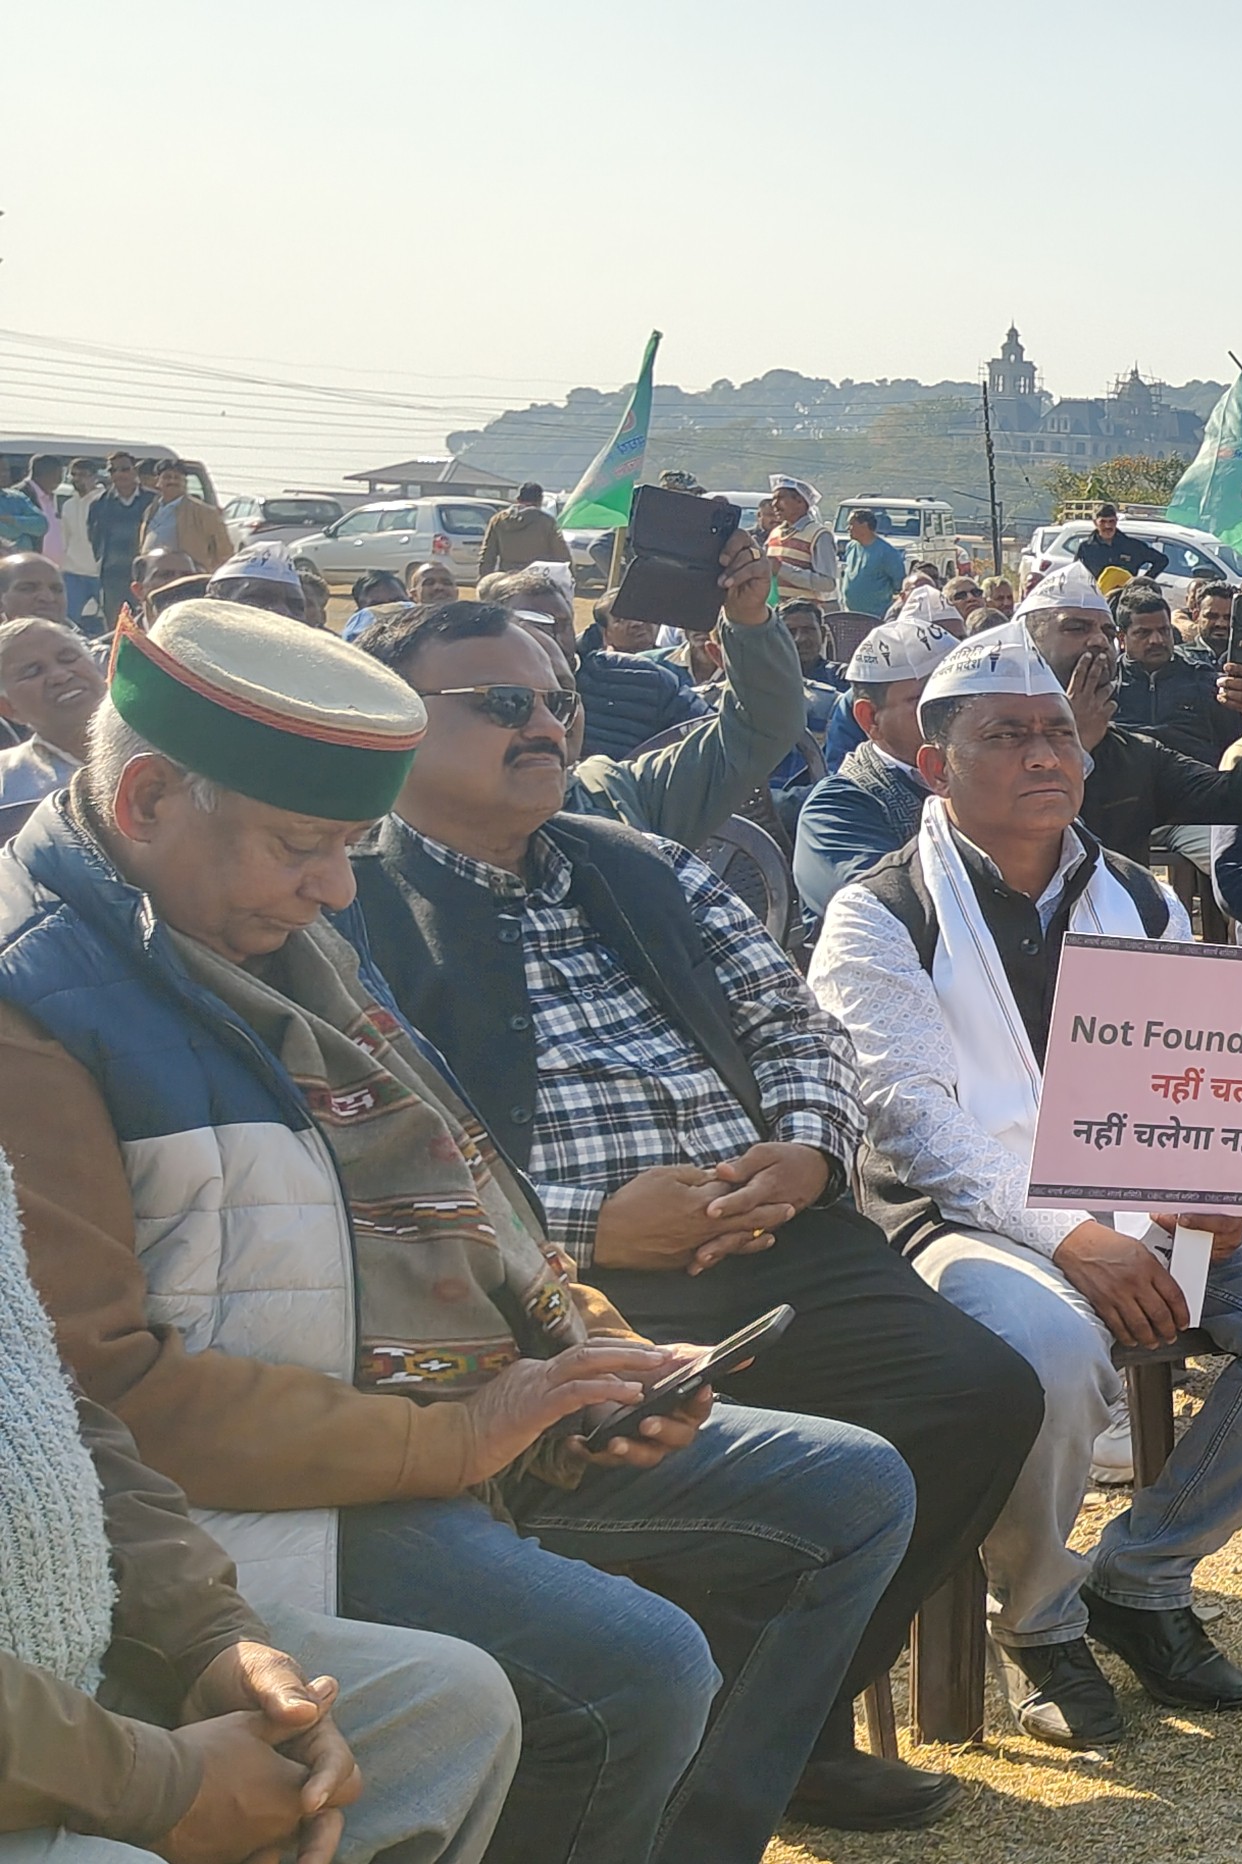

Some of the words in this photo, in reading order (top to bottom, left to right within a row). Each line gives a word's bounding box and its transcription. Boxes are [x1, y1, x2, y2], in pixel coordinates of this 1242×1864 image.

[1071, 1015, 1135, 1047] Not
[1151, 1067, 1205, 1105] नहीं
[1073, 1112, 1127, 1151] नहीं
[1133, 1116, 1214, 1150] चलेगा
